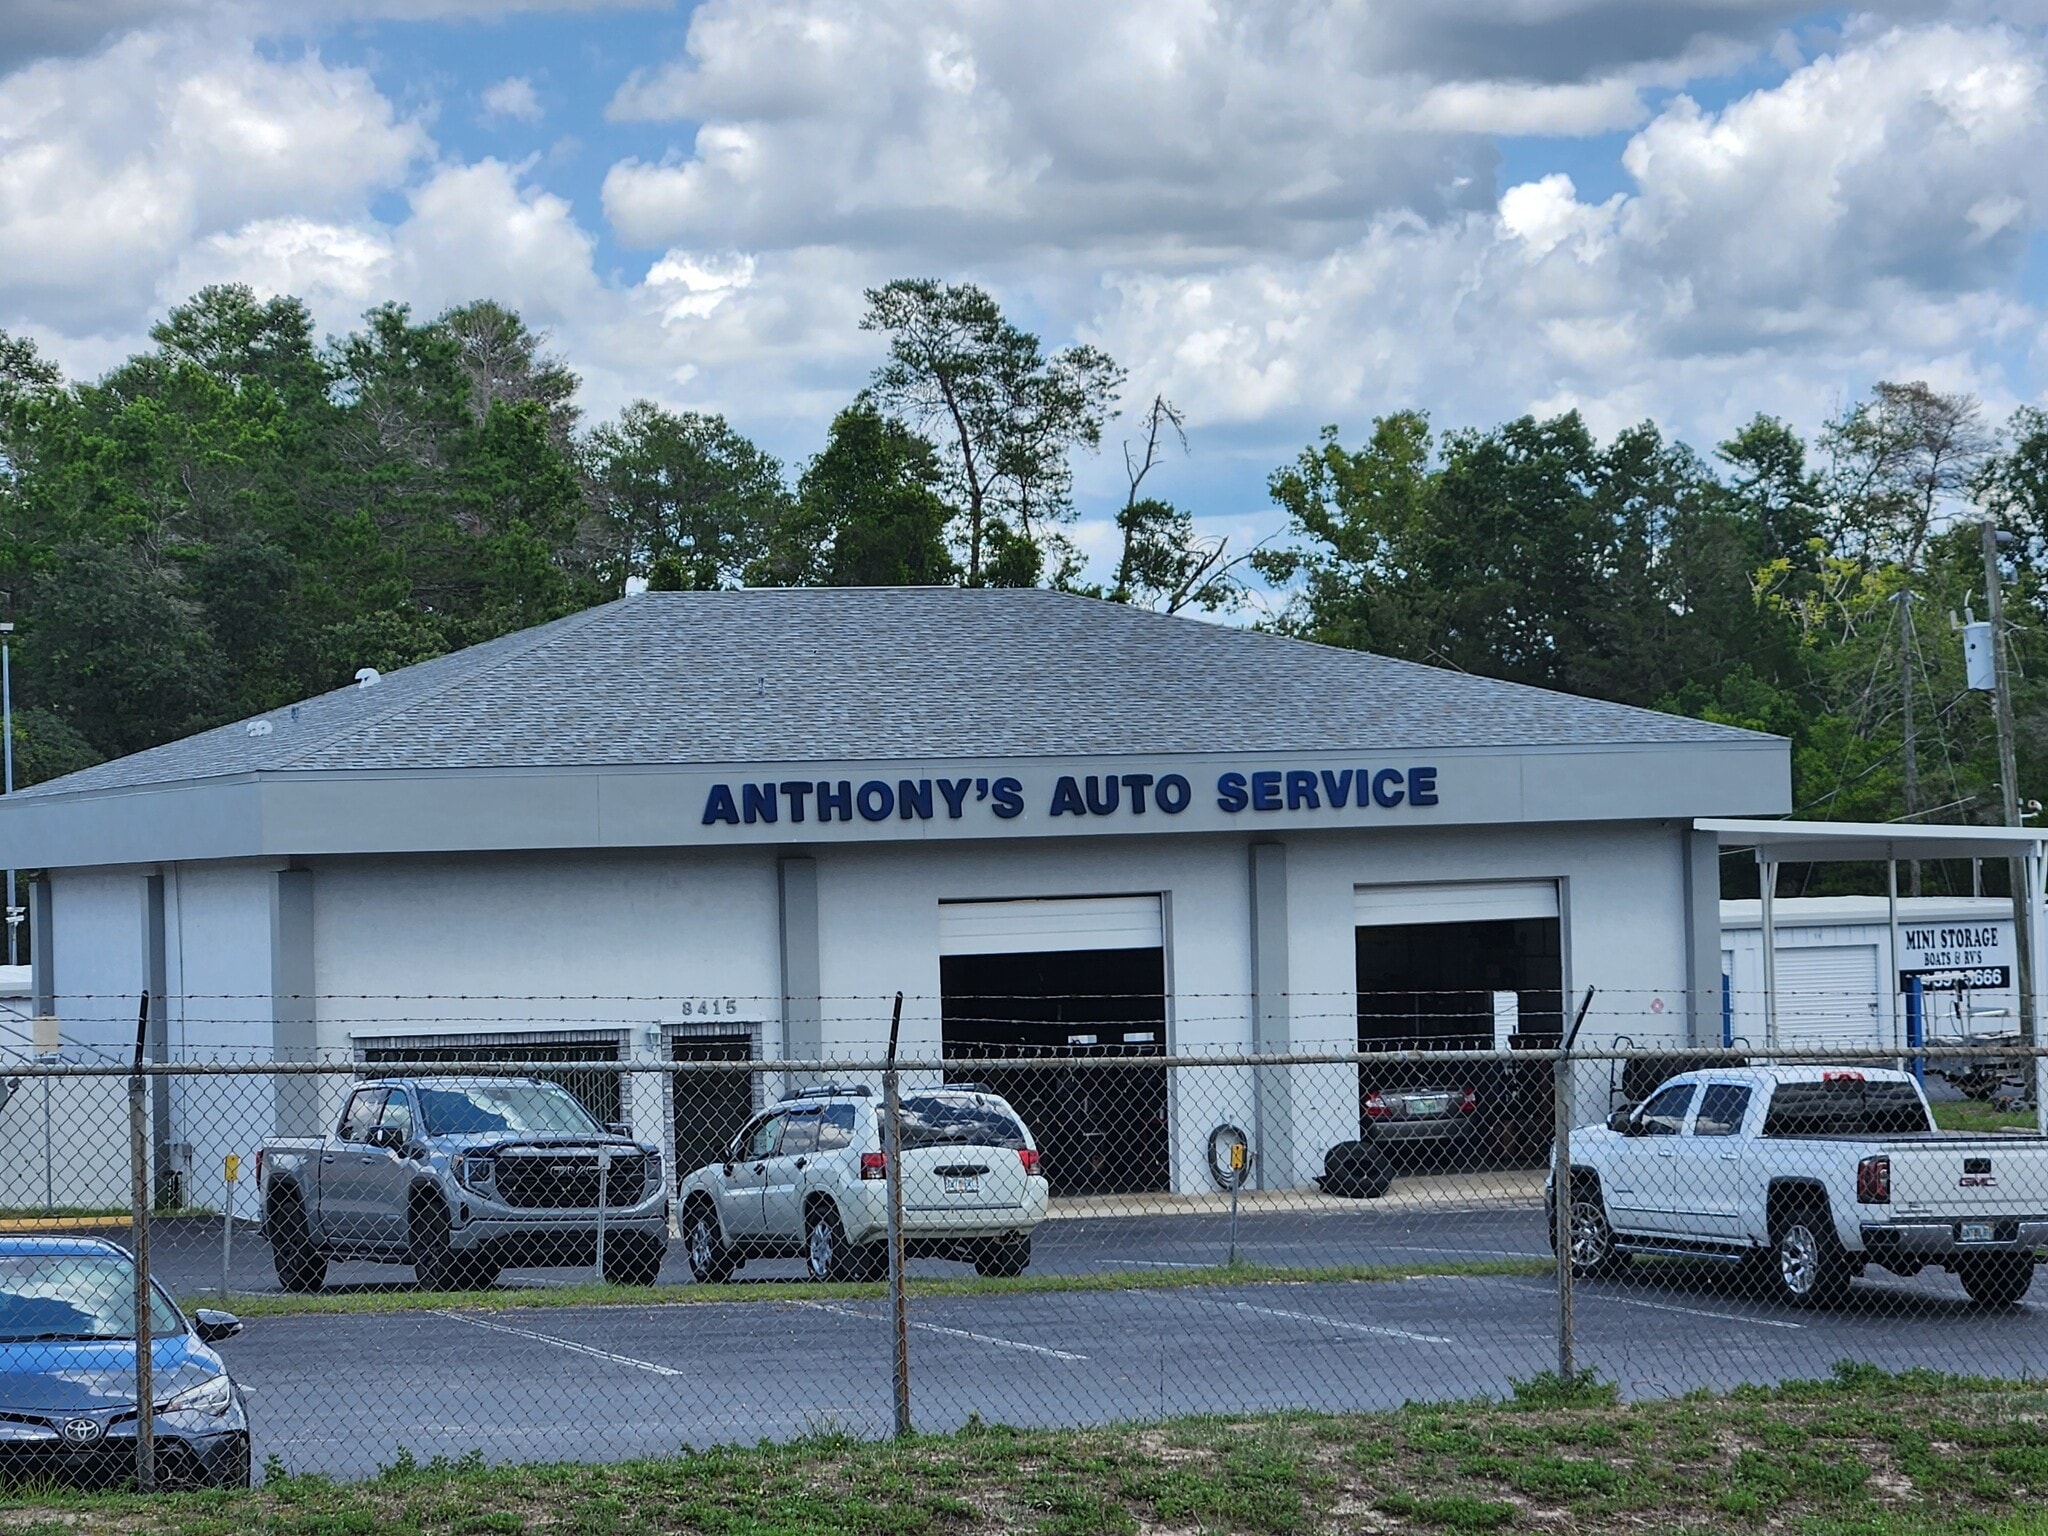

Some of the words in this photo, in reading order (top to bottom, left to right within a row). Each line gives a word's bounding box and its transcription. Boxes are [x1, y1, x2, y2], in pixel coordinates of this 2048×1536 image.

[701, 777, 1025, 825] ANTHONY'S
[1050, 773, 1192, 816] AUTO
[1216, 766, 1439, 813] SERVICE
[1905, 930, 1936, 950] MINI
[1940, 927, 1999, 949] STORAGE
[1924, 952, 1951, 966] BOATS
[1954, 952, 1961, 965] &
[682, 1000, 737, 1015] 8415
[1959, 1177, 1998, 1187] GMC
